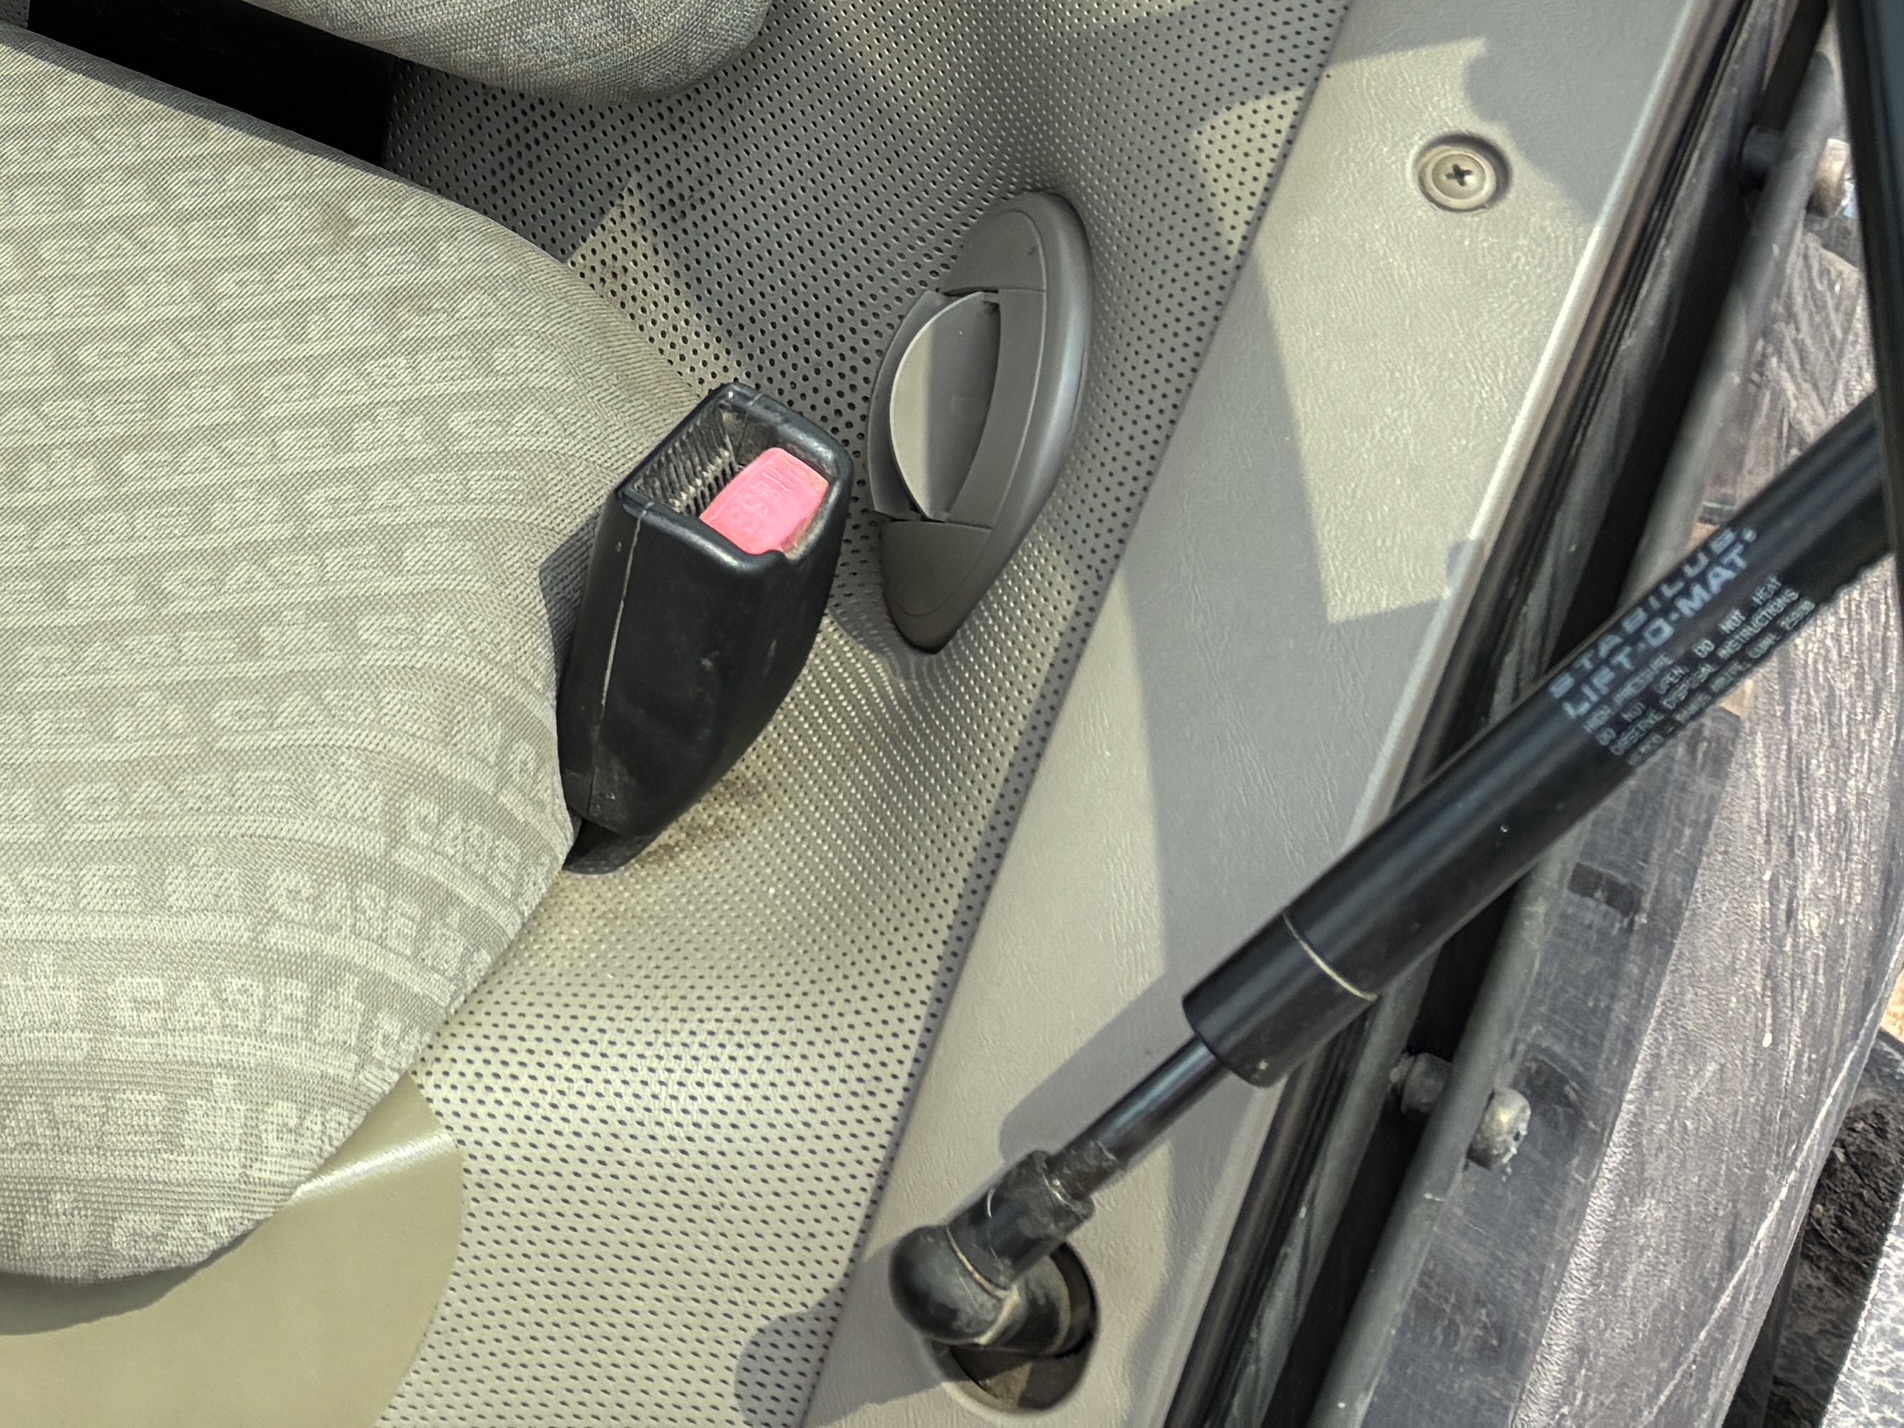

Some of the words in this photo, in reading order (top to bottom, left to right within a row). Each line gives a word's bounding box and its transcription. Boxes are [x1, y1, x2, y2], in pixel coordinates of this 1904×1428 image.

[1549, 527, 1737, 699] STABILUS
[1694, 638, 1715, 658] DO
[1718, 607, 1746, 635] NOT
[1751, 573, 1783, 606] HEAT
[1716, 587, 1800, 660] INSTRUCTIONS
[18, 623, 239, 674] CASE
[211, 687, 438, 736] CASE
[62, 767, 294, 823] CASE
[267, 869, 420, 946] CASE
[106, 972, 309, 1039] CASE
